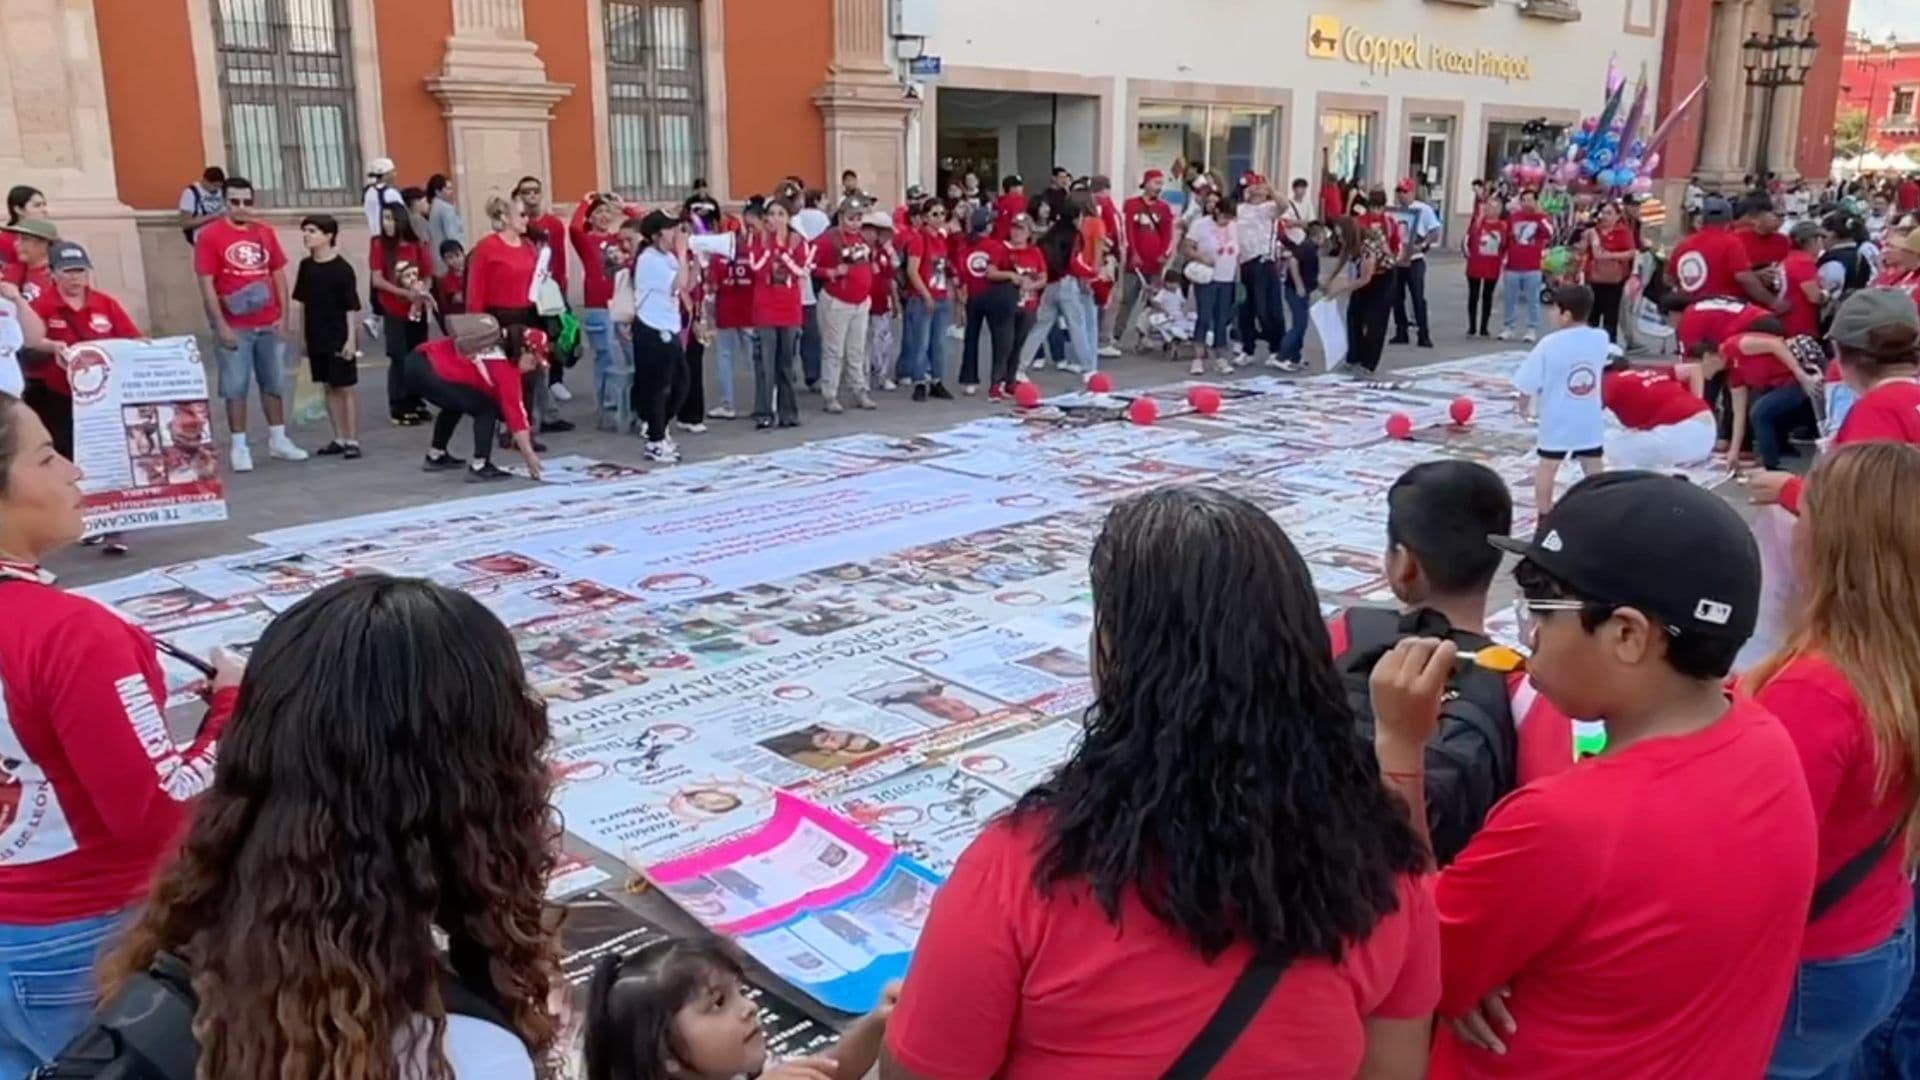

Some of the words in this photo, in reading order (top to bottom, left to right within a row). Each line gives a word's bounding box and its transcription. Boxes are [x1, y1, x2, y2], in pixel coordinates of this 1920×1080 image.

[1343, 26, 1423, 77] Coppel
[1429, 44, 1473, 73] Plaza
[1475, 49, 1530, 85] Principal
[86, 511, 160, 532] BUSCAMO
[164, 508, 182, 518] TE
[114, 672, 173, 759] MADRES
[554, 660, 767, 729] DESAPARECIDA
